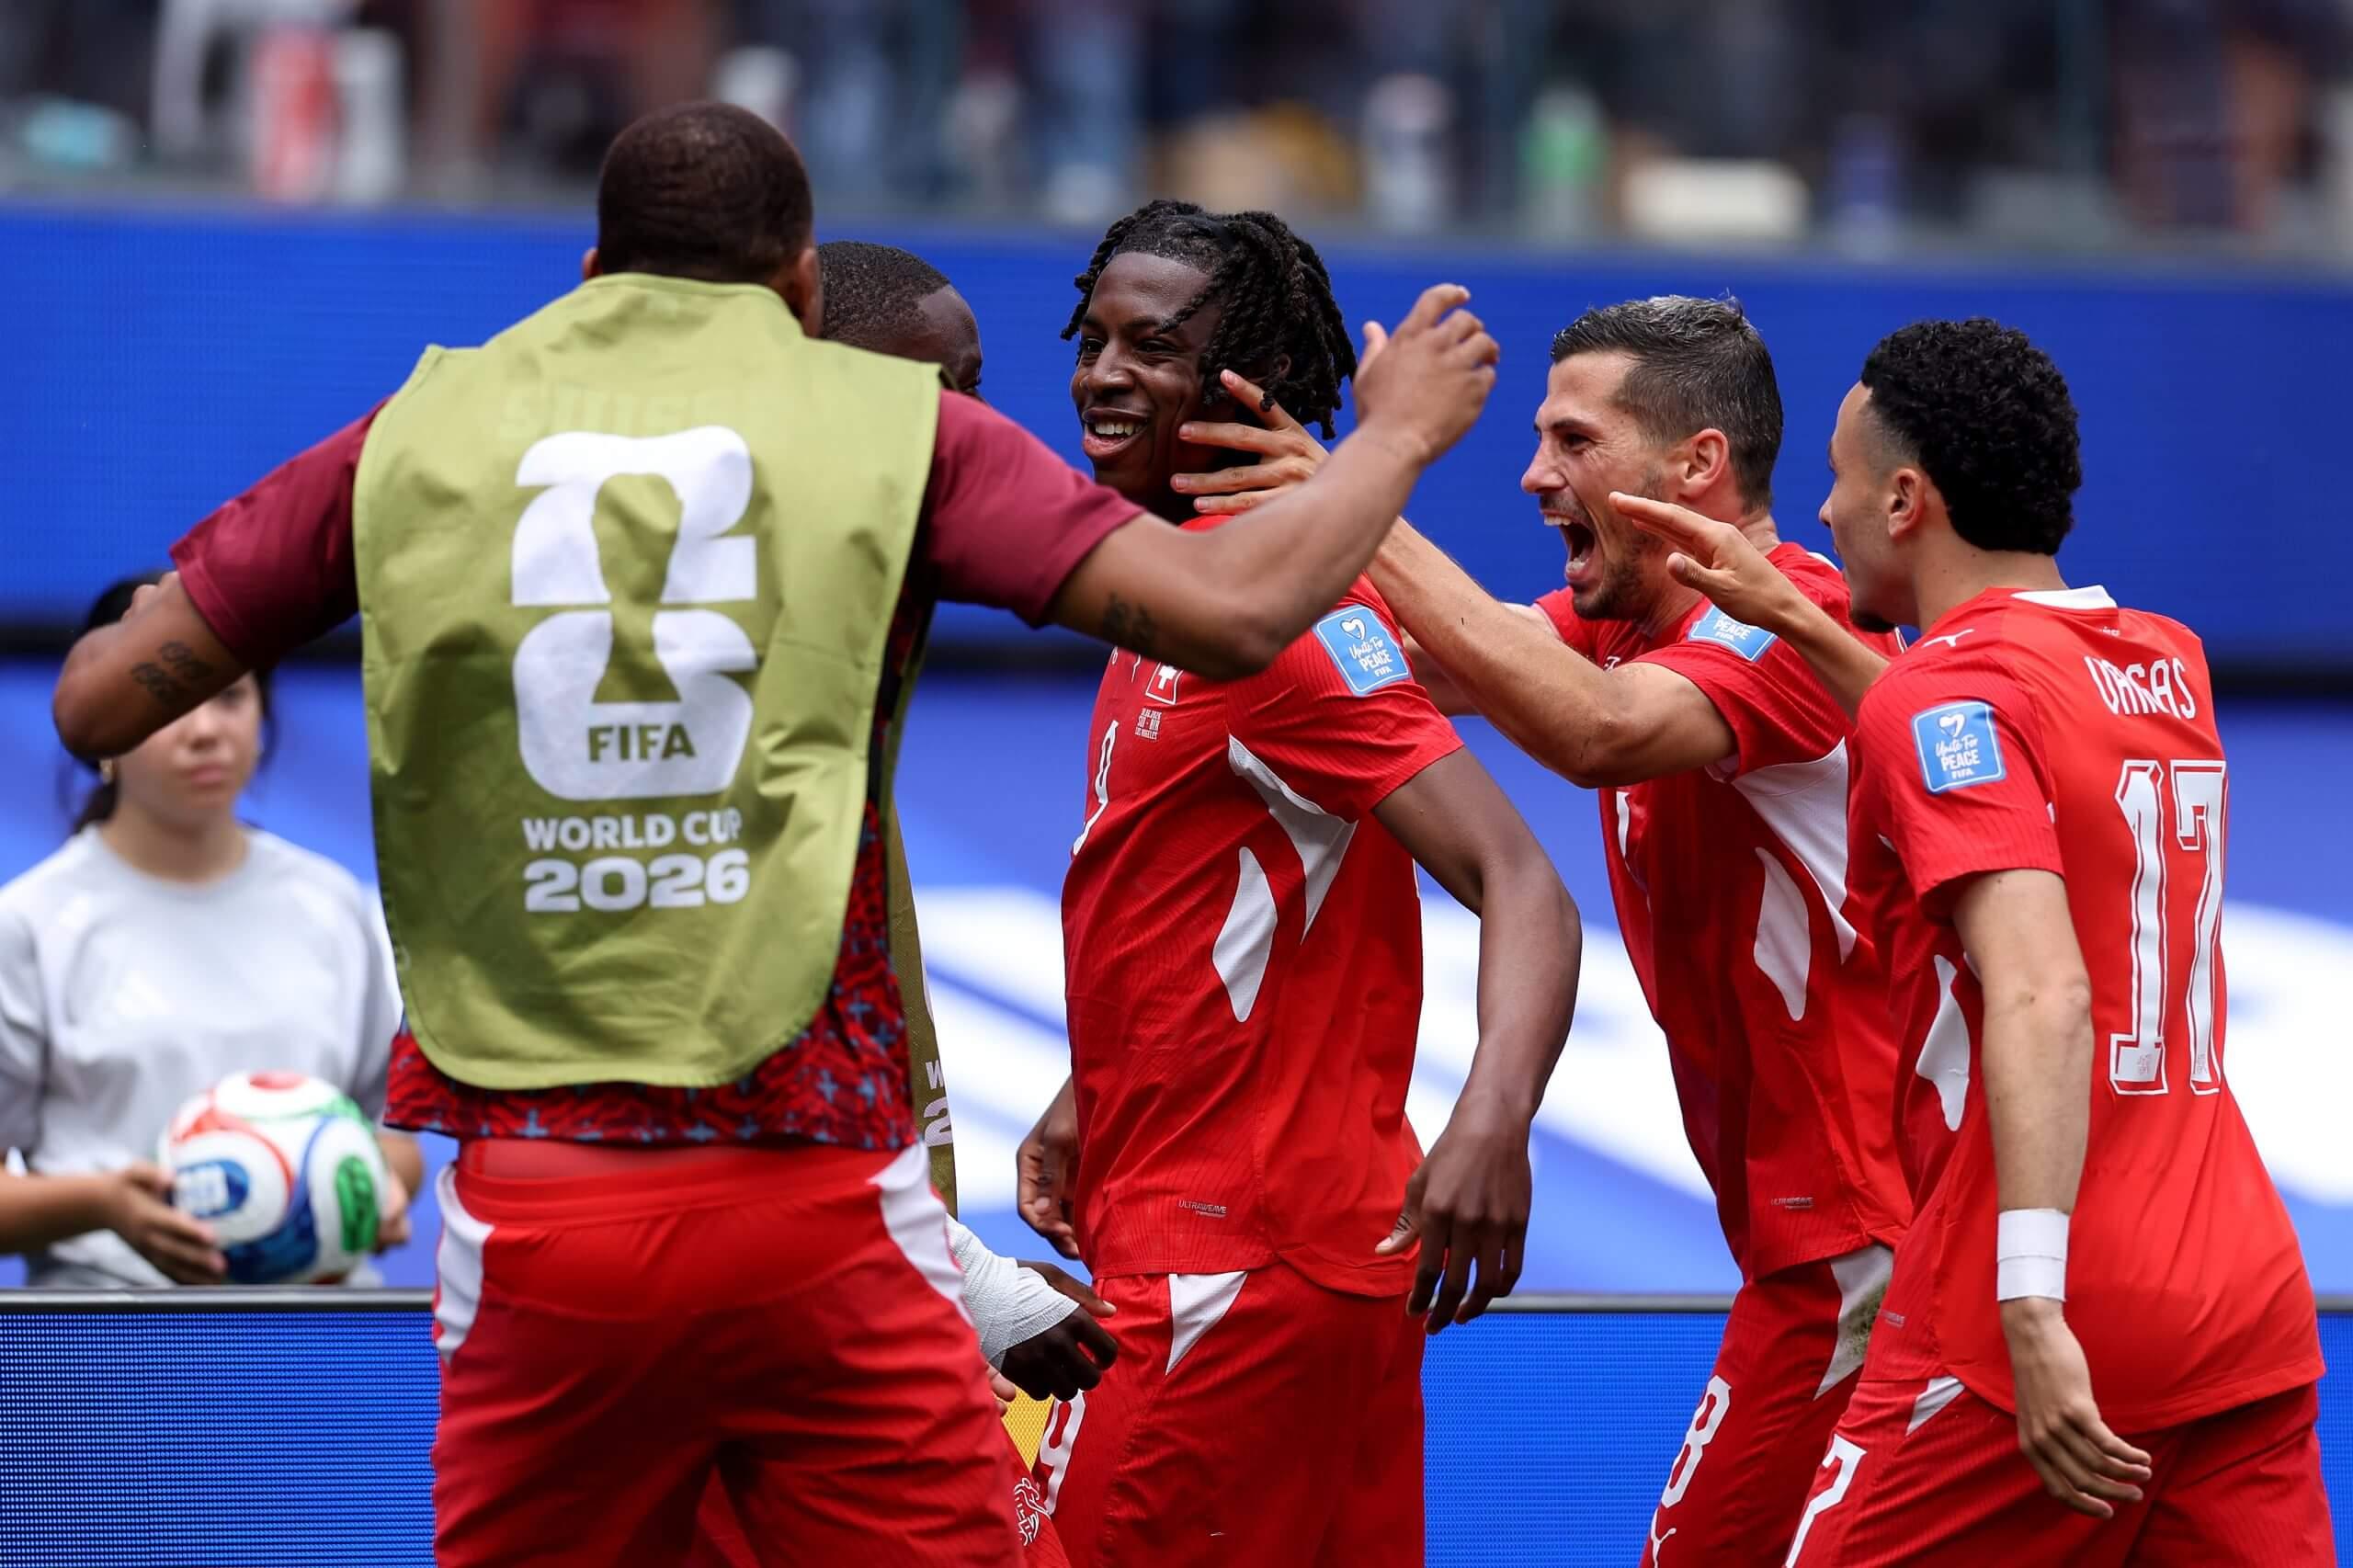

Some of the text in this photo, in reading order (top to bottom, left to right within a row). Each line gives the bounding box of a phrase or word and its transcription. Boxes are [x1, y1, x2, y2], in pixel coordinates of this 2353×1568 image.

[1712, 619, 1751, 641] PEACE
[1359, 649, 1393, 672] PEACE
[1374, 665, 1393, 677] FIFA
[2084, 655, 2196, 720] VARGAS
[587, 722, 696, 763] FIFA
[1940, 749, 1981, 772] PEACE
[1951, 767, 1975, 779] FIFA
[521, 812, 676, 851] WORLD
[523, 847, 751, 913] 2026
[2109, 759, 2227, 1096] 17
[1040, 1388, 1086, 1517] 9
[1661, 1374, 1732, 1509] 8
[1784, 1433, 1869, 1568] 7
